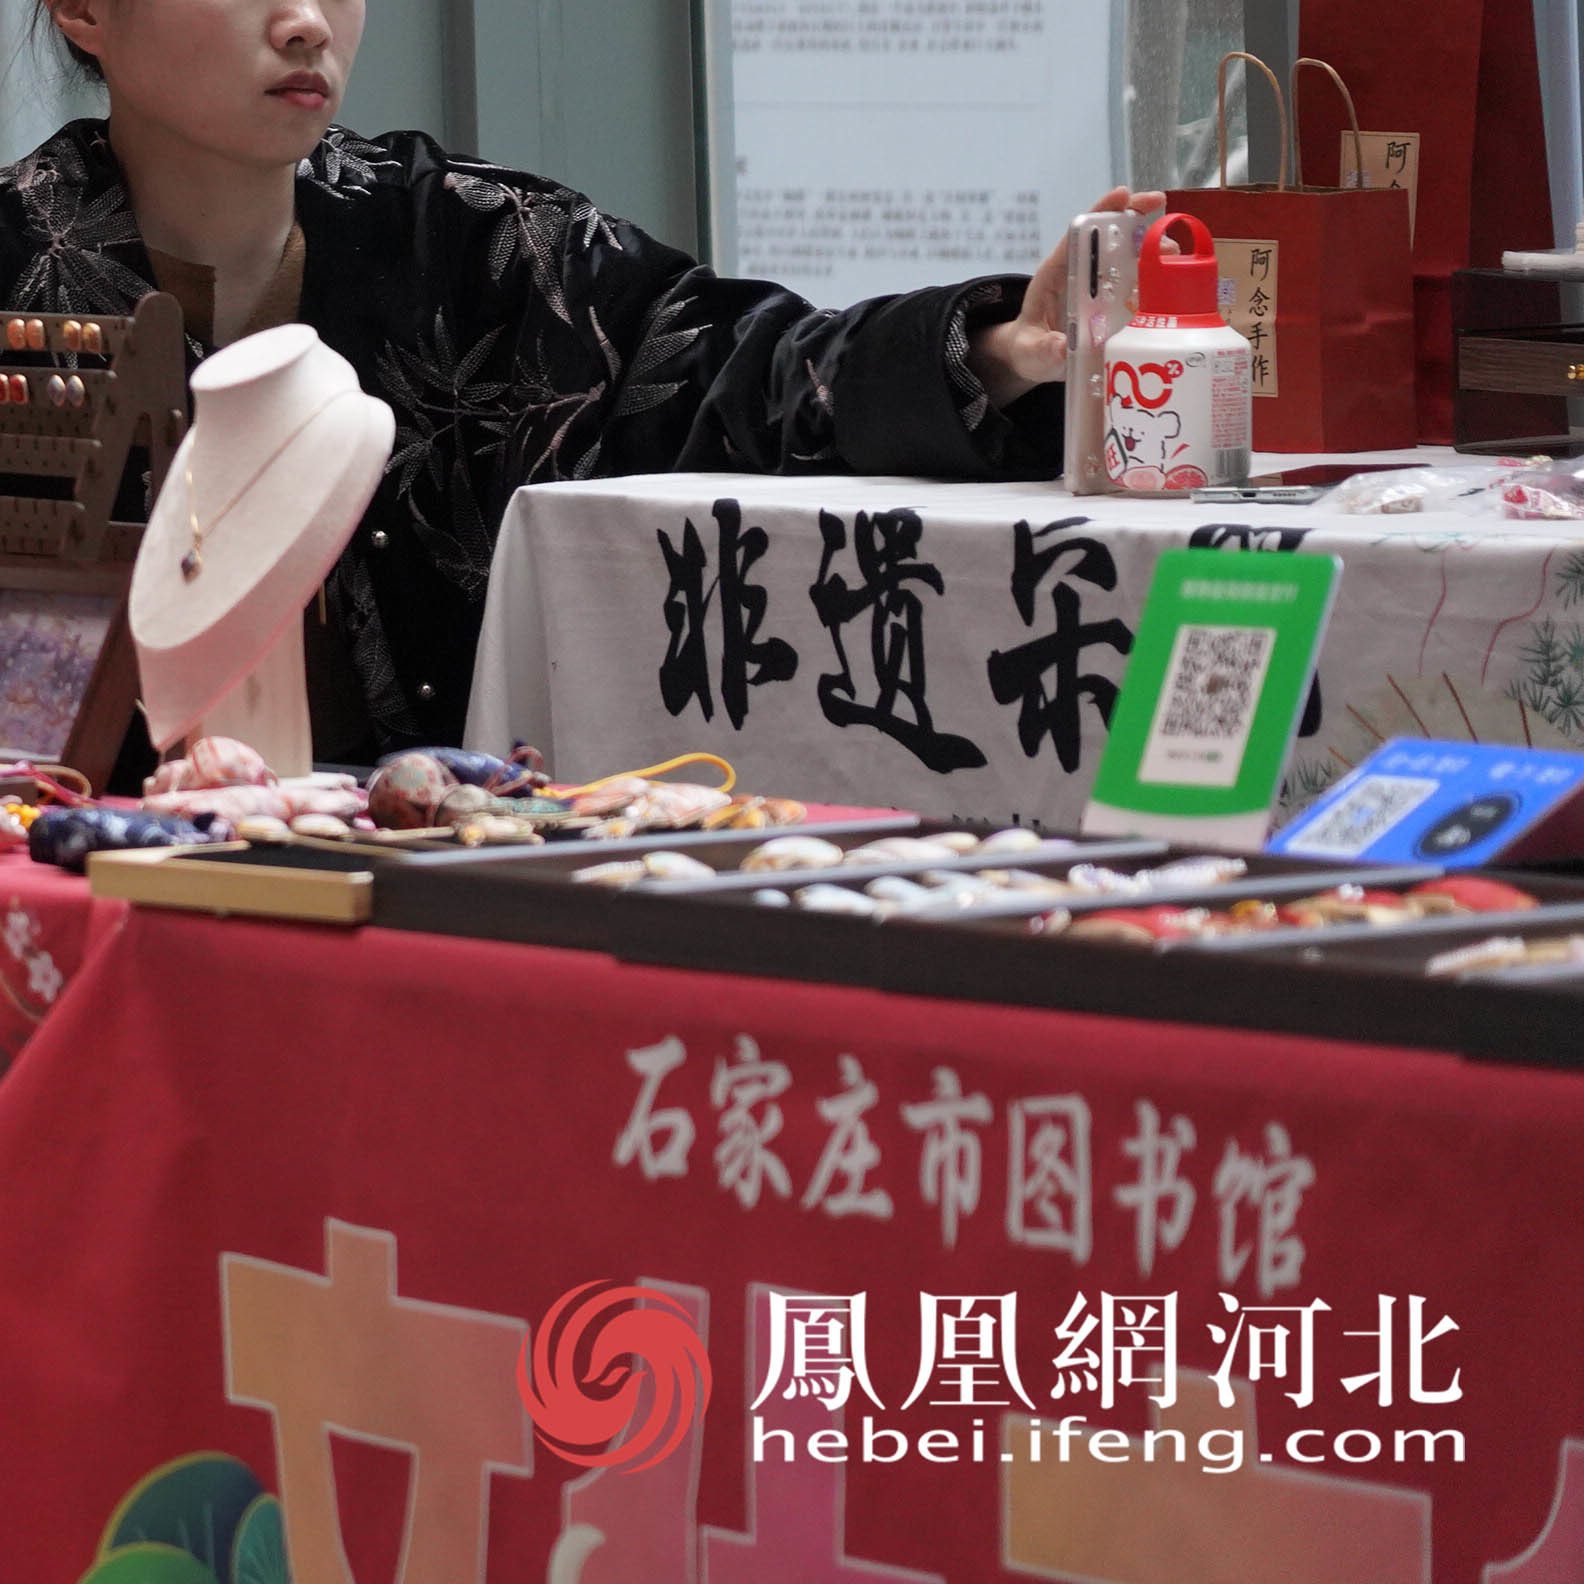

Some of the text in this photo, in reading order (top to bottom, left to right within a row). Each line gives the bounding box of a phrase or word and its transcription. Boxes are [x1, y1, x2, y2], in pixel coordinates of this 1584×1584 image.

[1385, 141, 1412, 190] 阿
[1247, 248, 1273, 387] 阿念手作
[656, 498, 1323, 774] 非遗宋
[613, 1033, 1316, 1298] 石家庄市图书馆
